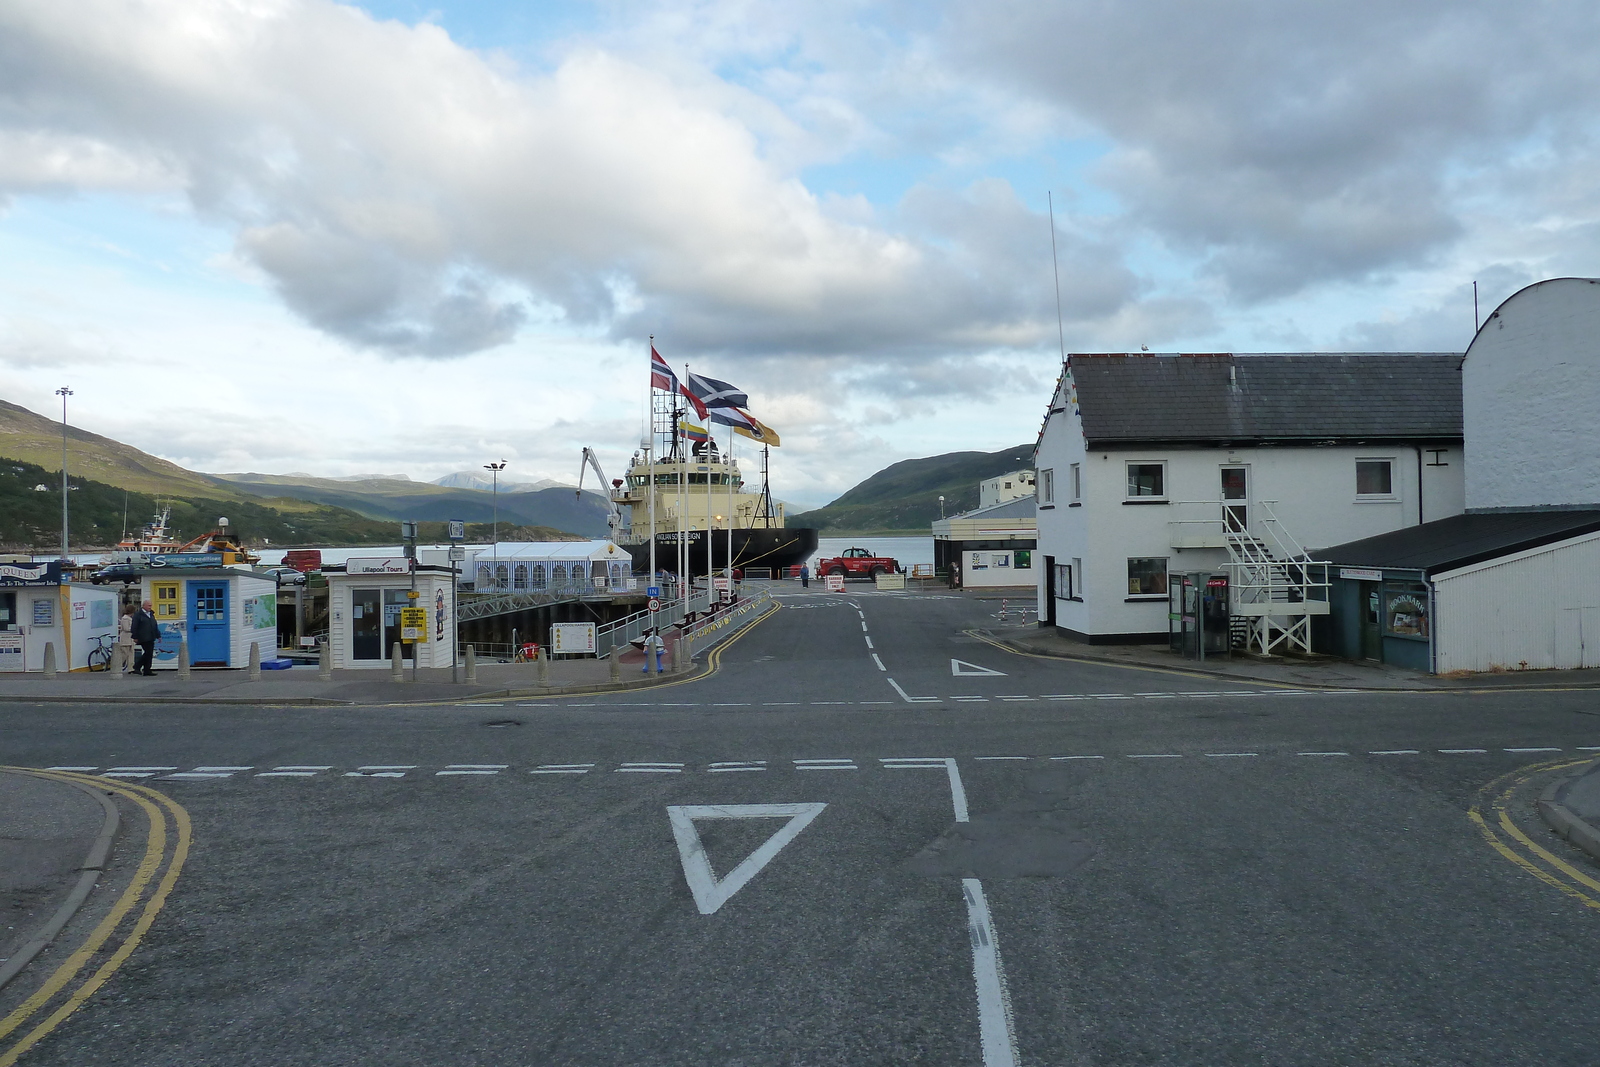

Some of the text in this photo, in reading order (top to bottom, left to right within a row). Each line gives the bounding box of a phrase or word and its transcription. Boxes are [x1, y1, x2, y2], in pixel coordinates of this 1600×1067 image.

[672, 532, 701, 540] SOEEIGN
[3, 567, 37, 579] QUEEN
[362, 566, 386, 574] Ullapool
[1390, 594, 1425, 613] BOOKMARK
